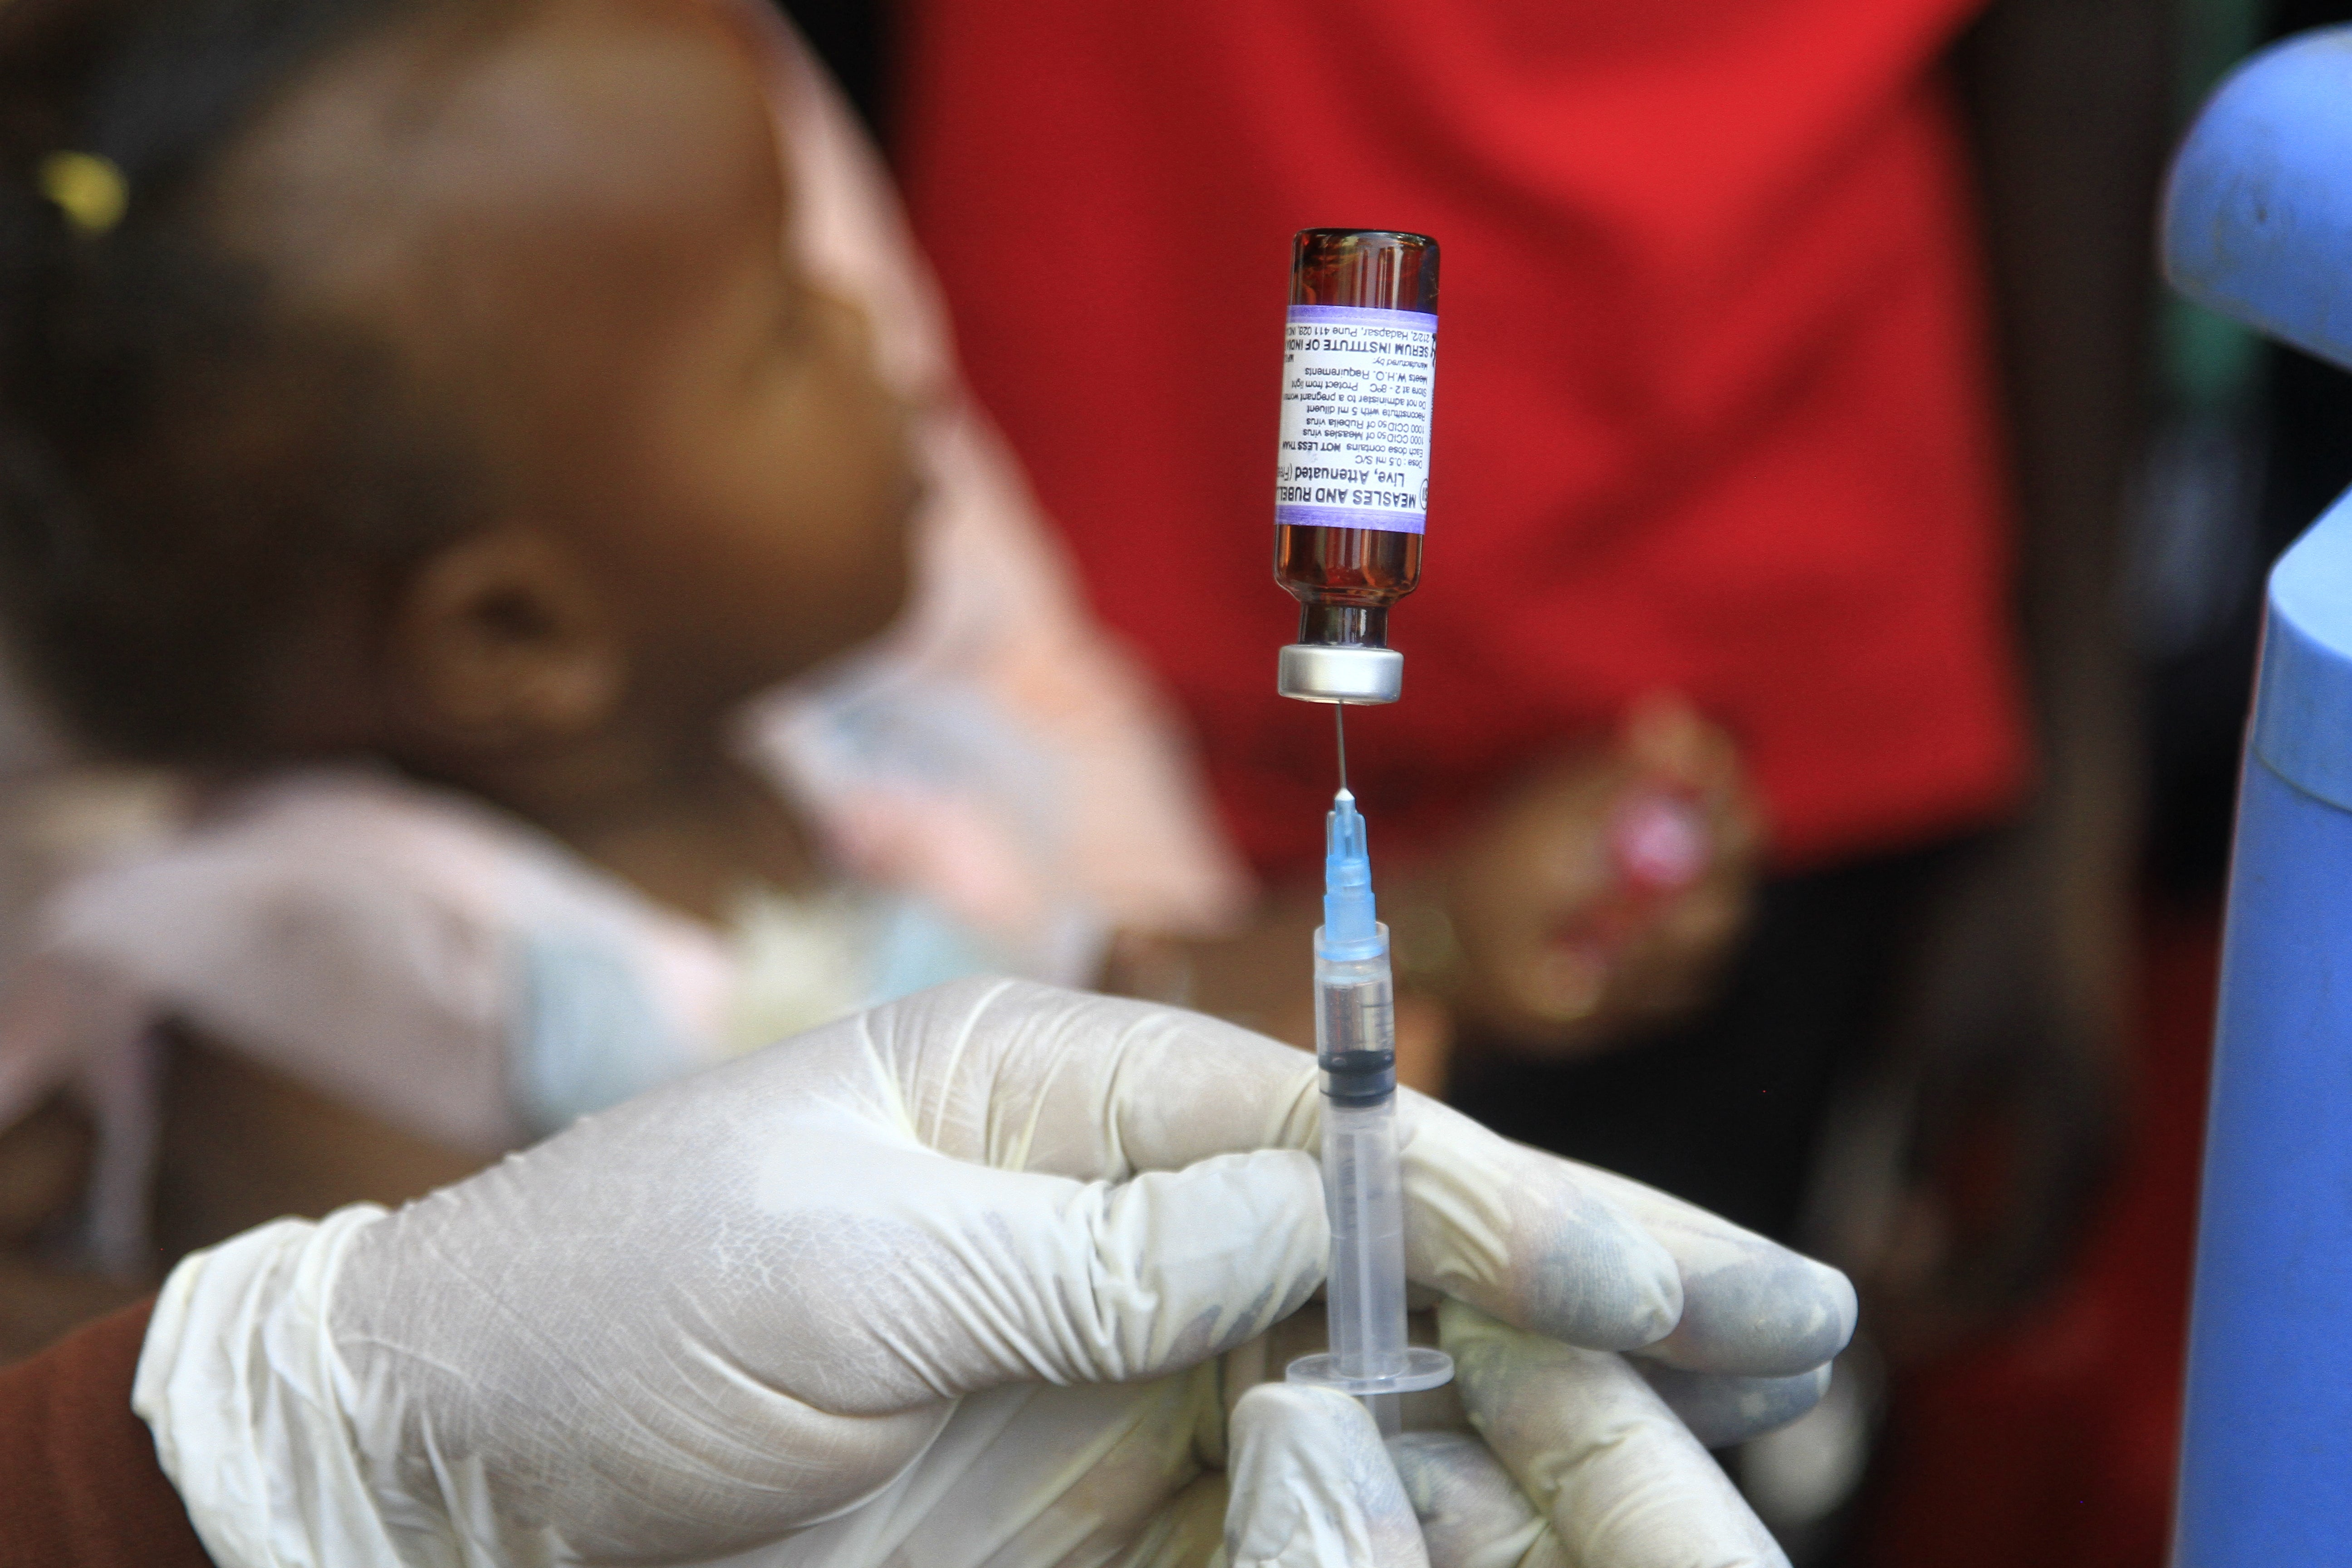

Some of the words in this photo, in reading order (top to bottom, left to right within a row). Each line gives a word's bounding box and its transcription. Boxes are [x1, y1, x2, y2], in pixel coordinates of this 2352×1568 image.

[1315, 327, 1330, 336] 411
[1333, 328, 1357, 338] Pune
[1361, 327, 1408, 340] Hadapsar,
[1305, 339, 1320, 351] OF
[1324, 339, 1391, 354] INSTITUTE
[1395, 343, 1429, 358] SERUM
[1386, 359, 1428, 370] Manufactured
[1305, 368, 1370, 380] Requirements
[1292, 378, 1304, 389] light
[1409, 374, 1428, 385] Meets
[1306, 381, 1323, 389] from
[1325, 381, 1358, 391] Protect
[1395, 385, 1401, 394] 2
[1300, 392, 1336, 402] pregnant
[1412, 387, 1427, 397] Store
[1347, 395, 1356, 403] to
[1358, 396, 1405, 407] administer
[1406, 399, 1417, 407] not
[1307, 405, 1335, 414] diluent
[1419, 401, 1426, 410] Do
[1338, 407, 1349, 415] ml
[1352, 407, 1357, 416] 5
[1361, 407, 1379, 417] with
[1382, 409, 1426, 421] Reconstitute
[1306, 418, 1326, 427] virus
[1328, 419, 1364, 429] Rubella
[1367, 421, 1376, 430] of
[1303, 429, 1322, 438] virus
[1411, 424, 1424, 434] 1000
[1324, 430, 1363, 441] Measles
[1366, 432, 1375, 441] of
[1410, 436, 1424, 445] 1000
[1282, 441, 1296, 450] THAN
[1298, 441, 1318, 451] LESS
[1320, 442, 1341, 452] NOT
[1347, 444, 1385, 453] contains
[1388, 446, 1407, 456] dose
[1409, 448, 1423, 458] Each
[1355, 455, 1373, 465] S/C
[1376, 456, 1387, 465] ml
[1389, 457, 1401, 466] 0.5
[1408, 459, 1422, 469] Dose
[1295, 467, 1369, 485] Attenuated
[1374, 469, 1405, 487] Live,
[1316, 488, 1348, 504] AND
[1353, 490, 1416, 509] MEASLES
